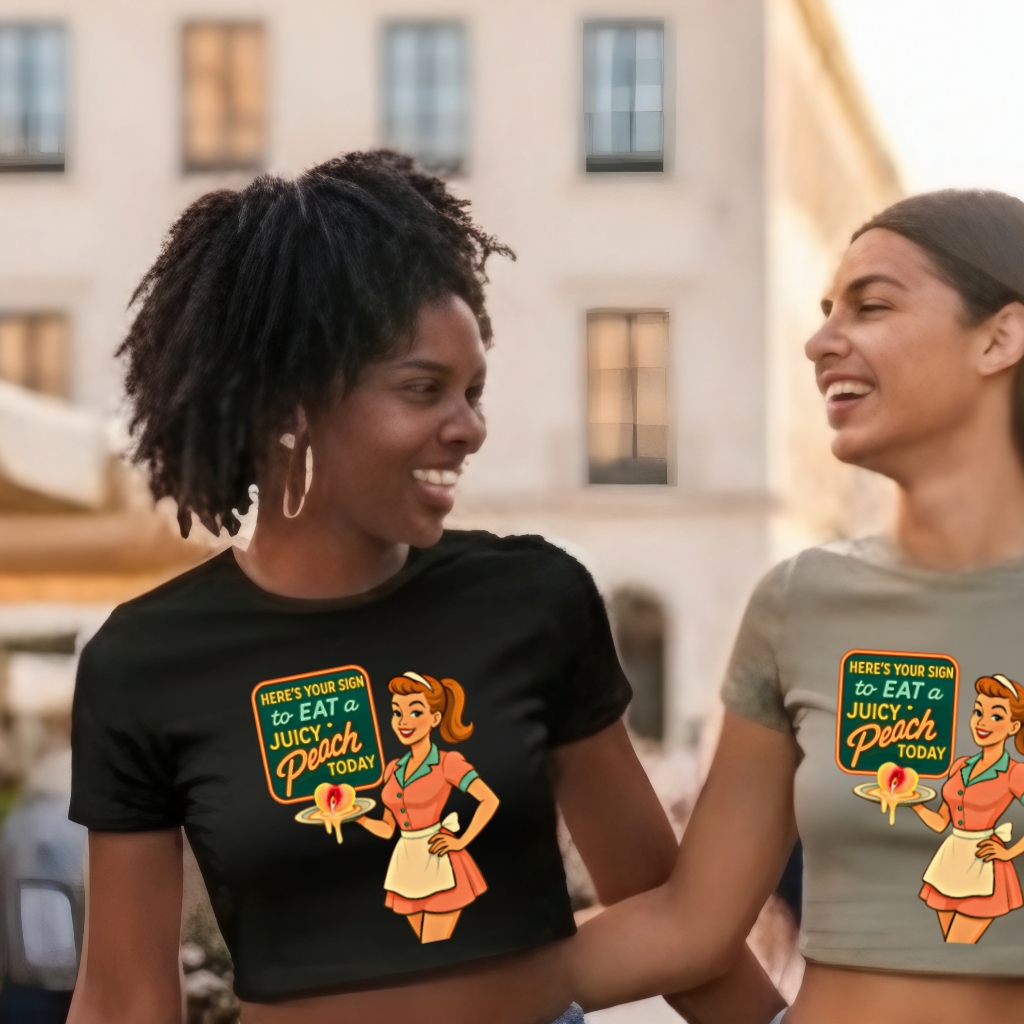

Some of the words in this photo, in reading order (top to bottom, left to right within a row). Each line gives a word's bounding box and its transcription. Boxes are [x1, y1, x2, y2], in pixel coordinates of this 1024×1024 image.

[849, 661, 891, 675] HERE'S
[894, 663, 925, 677] YOUR
[928, 666, 954, 679] SIGN
[261, 687, 302, 706] HERE'S
[304, 681, 336, 697] YOUR
[338, 676, 365, 691] SIGN
[855, 680, 877, 696] to
[883, 680, 925, 699] EAT
[928, 688, 944, 700] a
[271, 710, 293, 726] to
[300, 697, 339, 721] EAT
[344, 700, 359, 712] a
[846, 702, 901, 721] JUICY
[270, 724, 321, 750] JUICY
[846, 708, 937, 768] Peach
[276, 721, 362, 797] Peach
[898, 744, 946, 760] TODAY
[327, 754, 375, 776] TODAY
